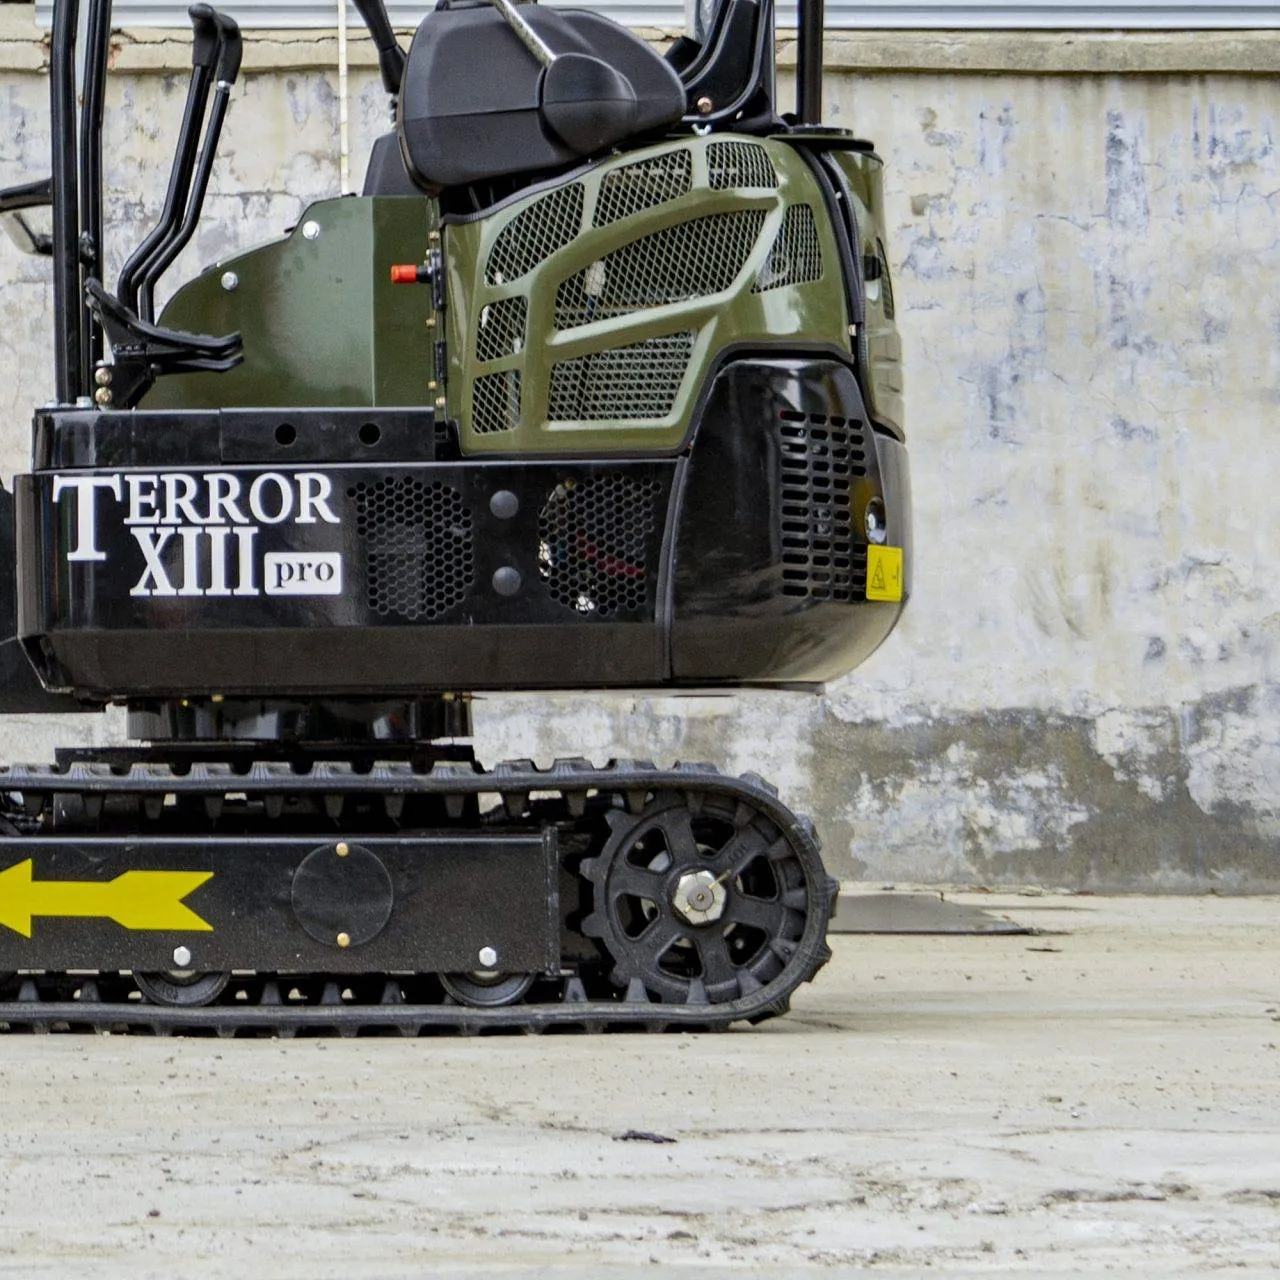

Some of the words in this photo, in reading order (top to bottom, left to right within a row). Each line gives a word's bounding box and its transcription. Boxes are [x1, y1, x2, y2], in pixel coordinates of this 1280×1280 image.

[52, 472, 340, 561] TERROR
[129, 525, 260, 596] XIII
[273, 560, 334, 590] pro
